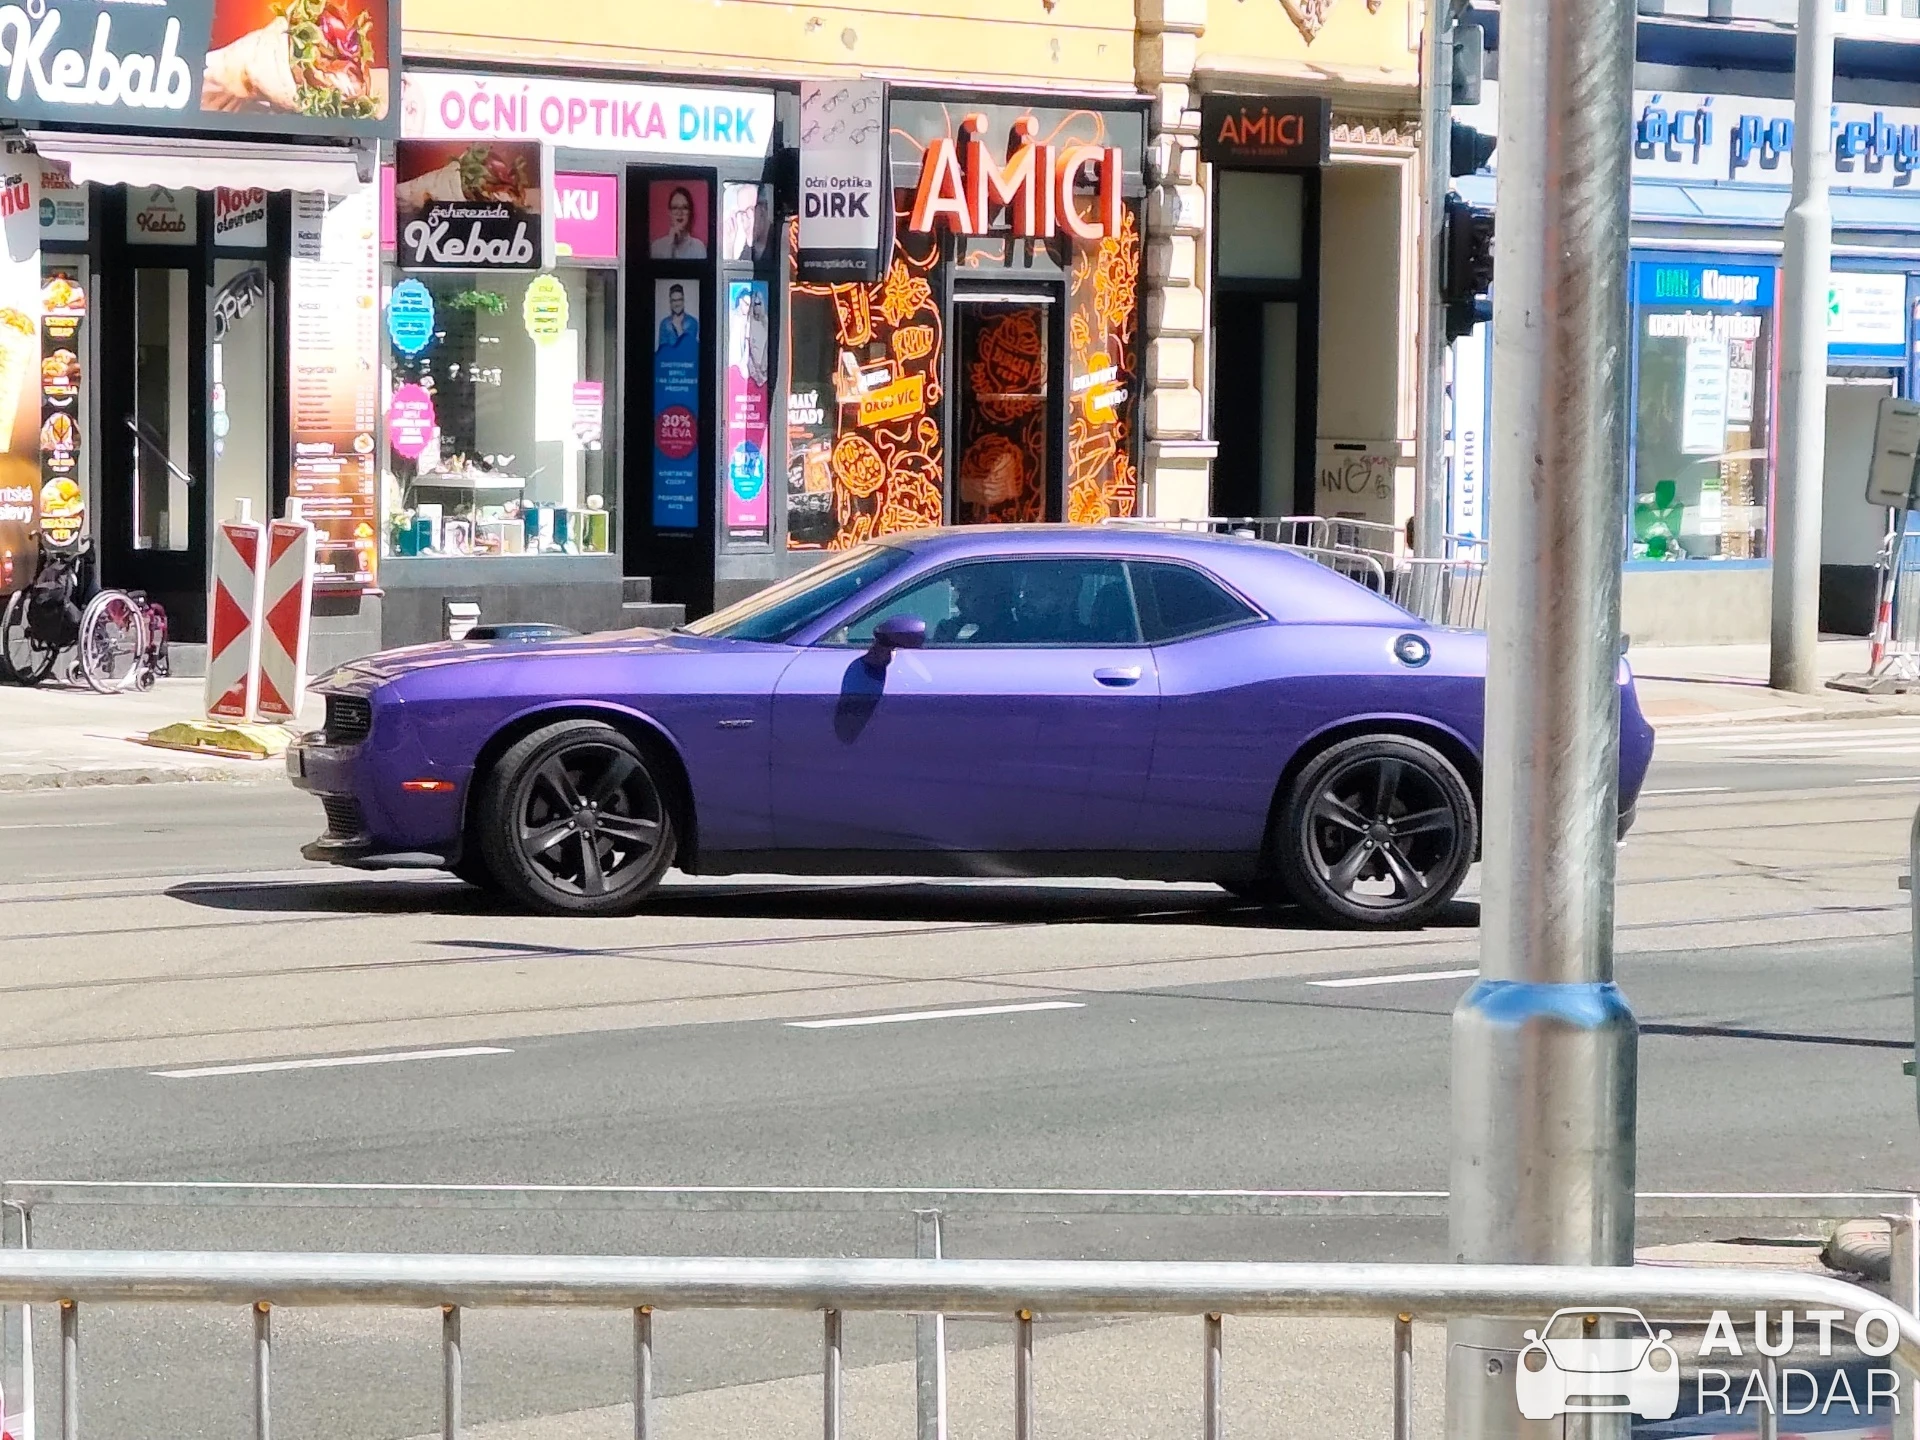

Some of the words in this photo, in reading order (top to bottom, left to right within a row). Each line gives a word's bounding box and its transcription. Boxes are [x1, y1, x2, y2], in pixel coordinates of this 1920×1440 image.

[0, 5, 192, 109] Kebab
[440, 81, 529, 132] OČNÍ
[540, 96, 667, 140] OPTIKA
[679, 104, 756, 144] DIRK
[1217, 106, 1304, 146] AMICI
[830, 176, 873, 191] Optika
[908, 112, 1124, 240] AMICI
[136, 212, 187, 232] Kebab
[805, 192, 871, 218] DIRK
[404, 220, 534, 264] Kebab
[1702, 269, 1760, 304] Kloupar
[661, 427, 692, 438] SLEVA
[662, 414, 691, 427] 30%
[1463, 430, 1475, 517] ELEKTRO
